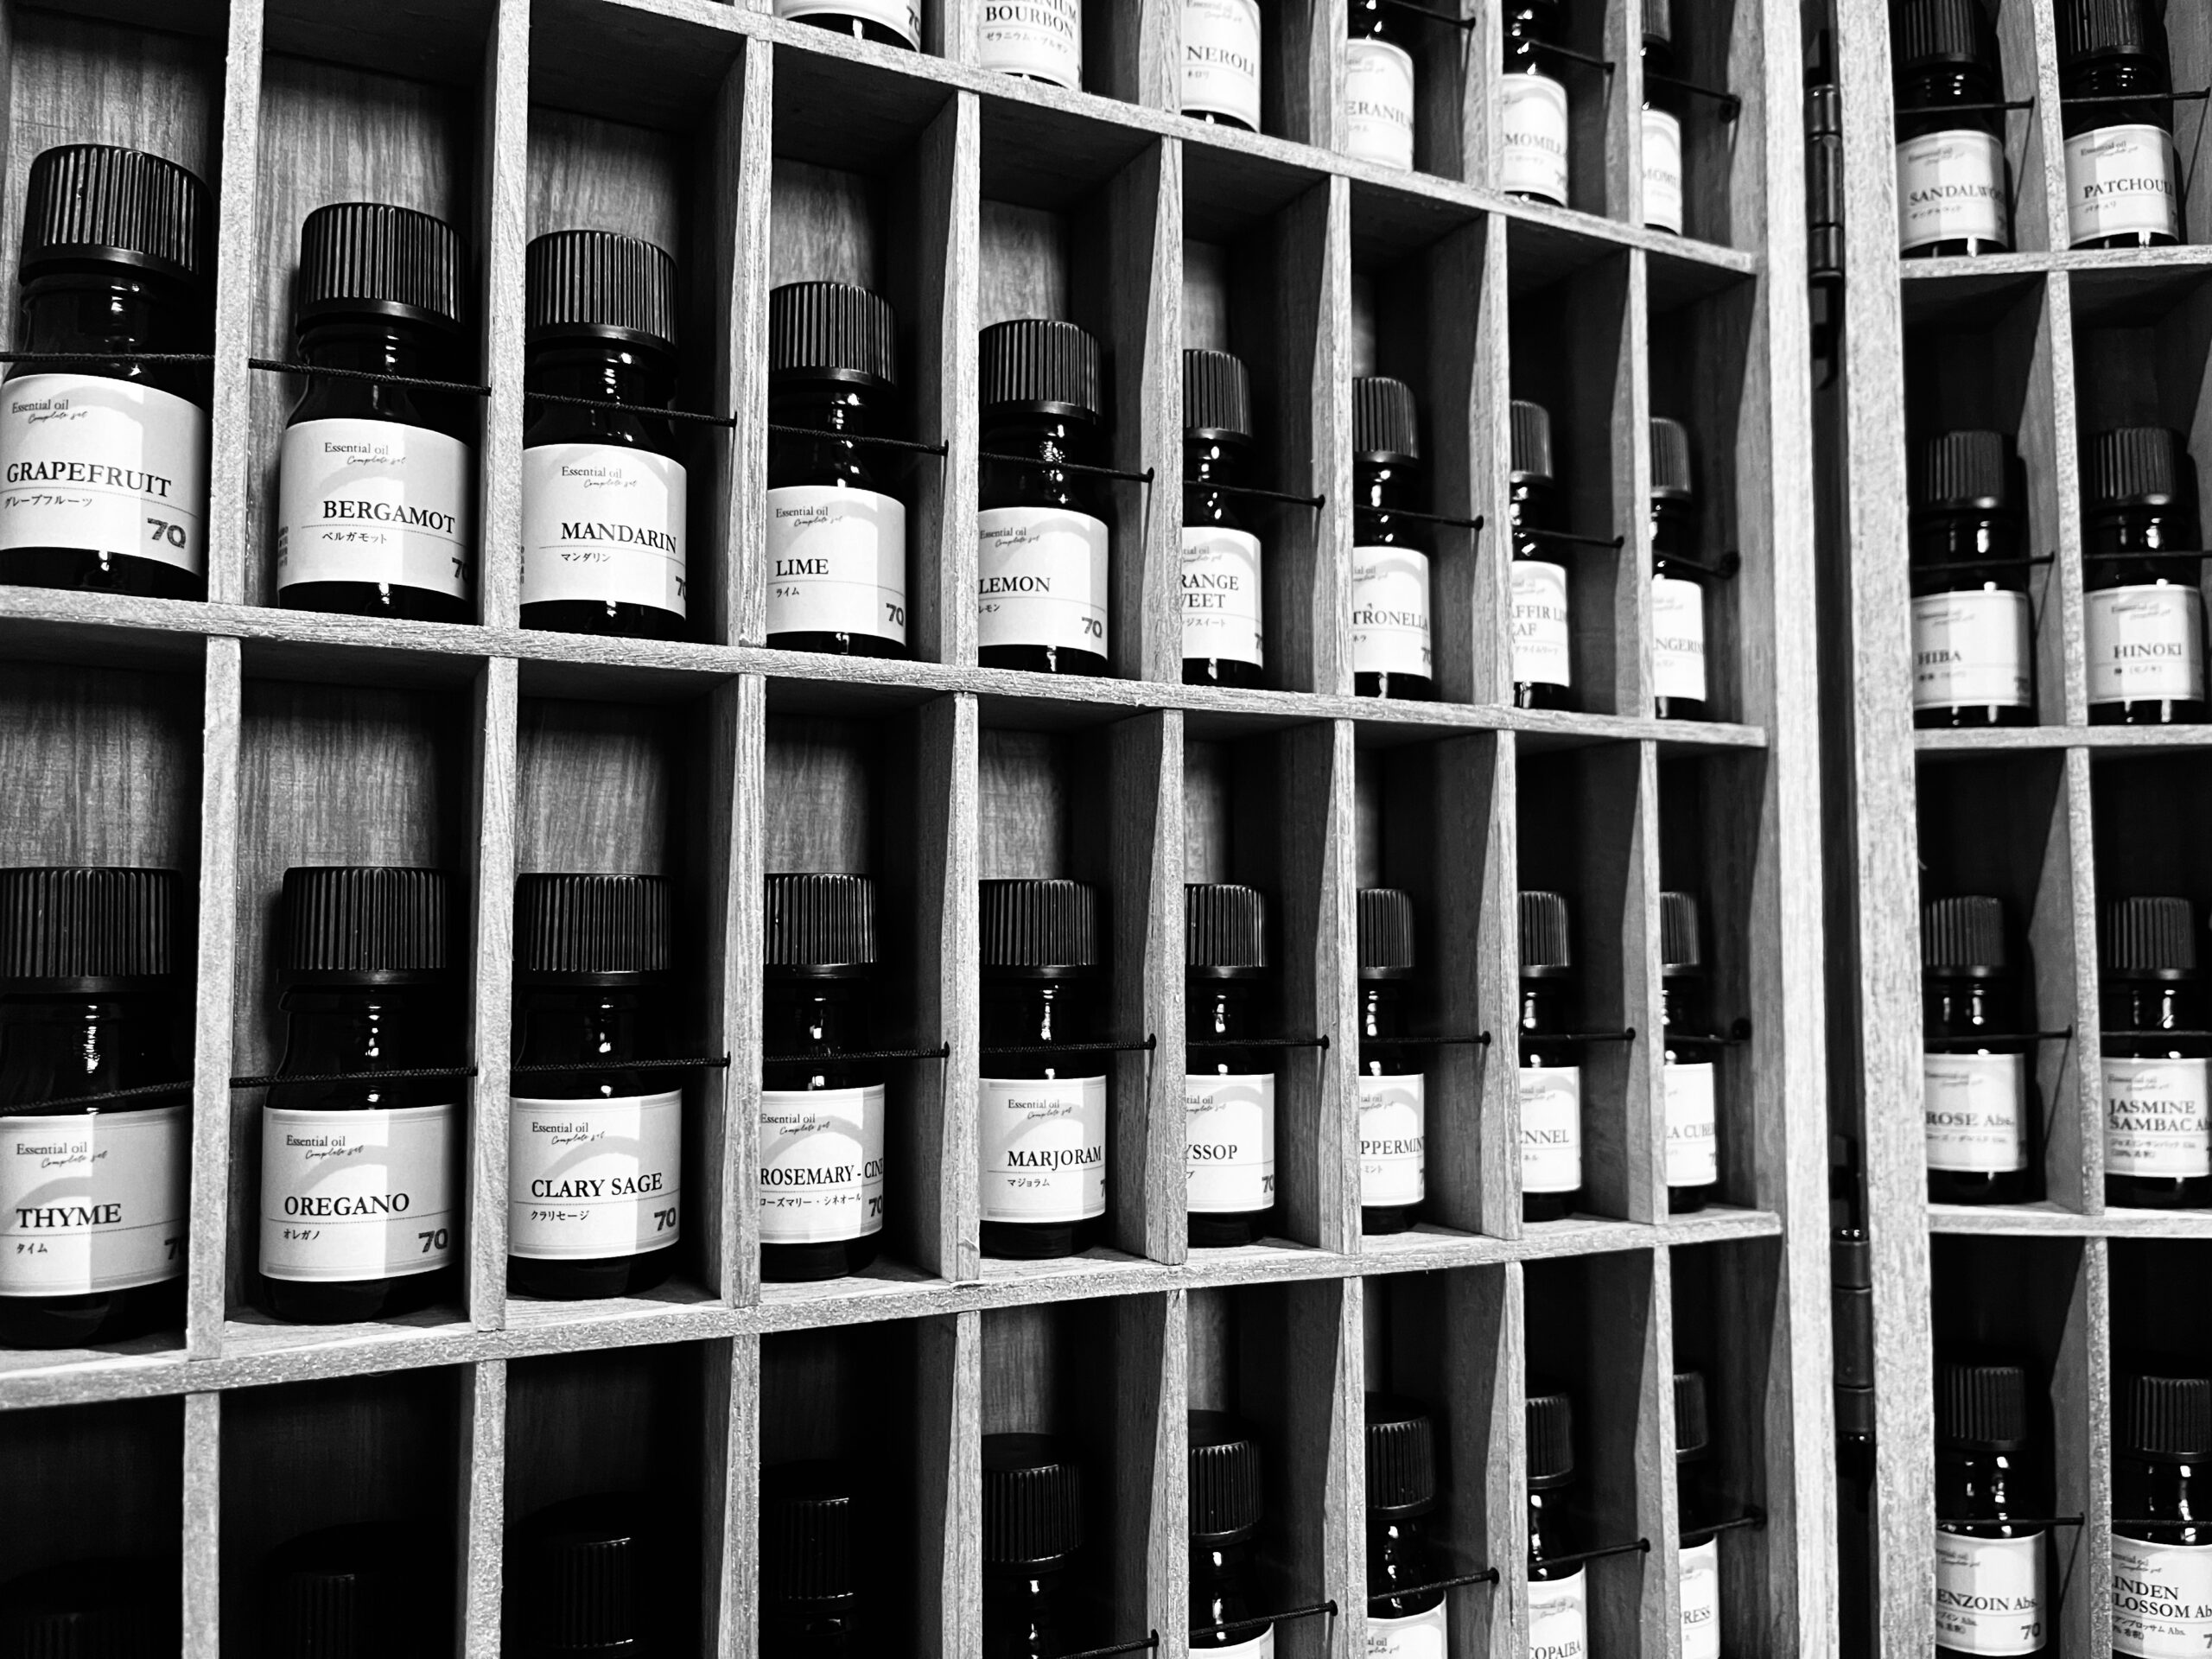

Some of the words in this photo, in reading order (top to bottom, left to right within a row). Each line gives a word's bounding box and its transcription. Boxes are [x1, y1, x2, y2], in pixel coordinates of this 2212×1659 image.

[985, 6, 1072, 40] BOURBON
[12, 399, 51, 414] Essential
[54, 398, 69, 410] oil
[325, 442, 371, 454] Essential
[374, 444, 389, 455] oil
[7, 461, 172, 498] GRAPEFRUIT
[561, 466, 606, 477] Essential
[609, 468, 622, 479] oil
[322, 500, 456, 534] BERGAMOT
[776, 506, 813, 518] Essential
[816, 506, 829, 516] oil
[146, 517, 187, 549] 70
[321, 531, 387, 544] ベルガモット
[561, 522, 677, 554] MANDARIN
[980, 527, 1014, 540] Essential
[561, 552, 611, 563] マンダリン
[776, 558, 830, 577] LIME
[978, 576, 1051, 595] LEMON
[1182, 574, 1239, 591] RANGE
[776, 587, 799, 598] ライム
[1182, 593, 1226, 608] EET
[885, 602, 905, 626] 70
[1353, 609, 1428, 632] TRONELLA
[1081, 616, 1103, 639] 70
[2113, 643, 2181, 659] HINOKI
[1007, 1098, 1046, 1109] Essential
[2107, 1098, 2196, 1116] JASMINE
[760, 1113, 800, 1124] Essential
[803, 1113, 816, 1123] oil
[1925, 1110, 1978, 1126] ROSE
[2109, 1115, 2193, 1132] SAMBAC
[531, 1122, 573, 1133] Essential
[575, 1122, 589, 1133] oil
[286, 1135, 328, 1147] Essential
[331, 1135, 346, 1147] oil
[1360, 1135, 1424, 1155] PPERMIN
[1522, 1129, 1569, 1145] NNEL
[16, 1142, 67, 1155] Essential
[71, 1141, 87, 1154] oil
[1185, 1144, 1237, 1160] YSSOP
[1007, 1146, 1102, 1172] MARJORAM
[760, 1165, 855, 1186] ROSEMARY
[864, 1158, 883, 1179] CINE
[531, 1179, 606, 1198] CLARY
[611, 1172, 663, 1196] SAGE
[1007, 1178, 1050, 1188] マジョラム
[284, 1192, 410, 1217] OREGANO
[16, 1204, 122, 1229] THYME
[531, 1210, 590, 1221] クラリセージ
[653, 1207, 677, 1231] 70
[283, 1228, 321, 1240] オレガノ
[418, 1228, 448, 1253] 70
[16, 1243, 48, 1254] タイム
[2113, 1575, 2179, 1600] INDEN
[1936, 1588, 2010, 1611] ENZOIN
[2113, 1592, 2190, 1618] LOSSOM
[2195, 1605, 2212, 1618] Ab
